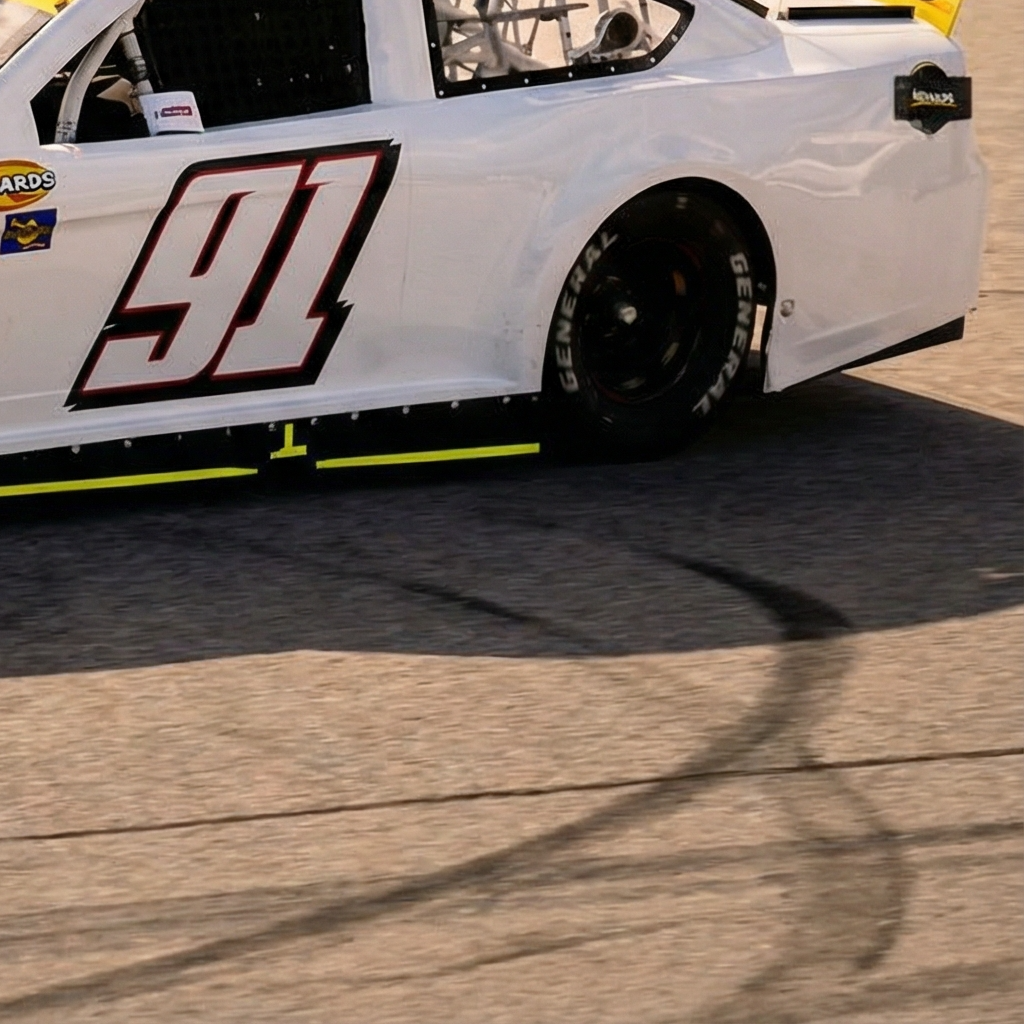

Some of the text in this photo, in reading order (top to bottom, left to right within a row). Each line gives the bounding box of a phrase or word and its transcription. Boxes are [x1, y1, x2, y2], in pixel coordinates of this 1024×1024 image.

[66, 142, 398, 410] 91
[555, 231, 618, 394] GENERAL
[692, 252, 753, 416] GENERAL
